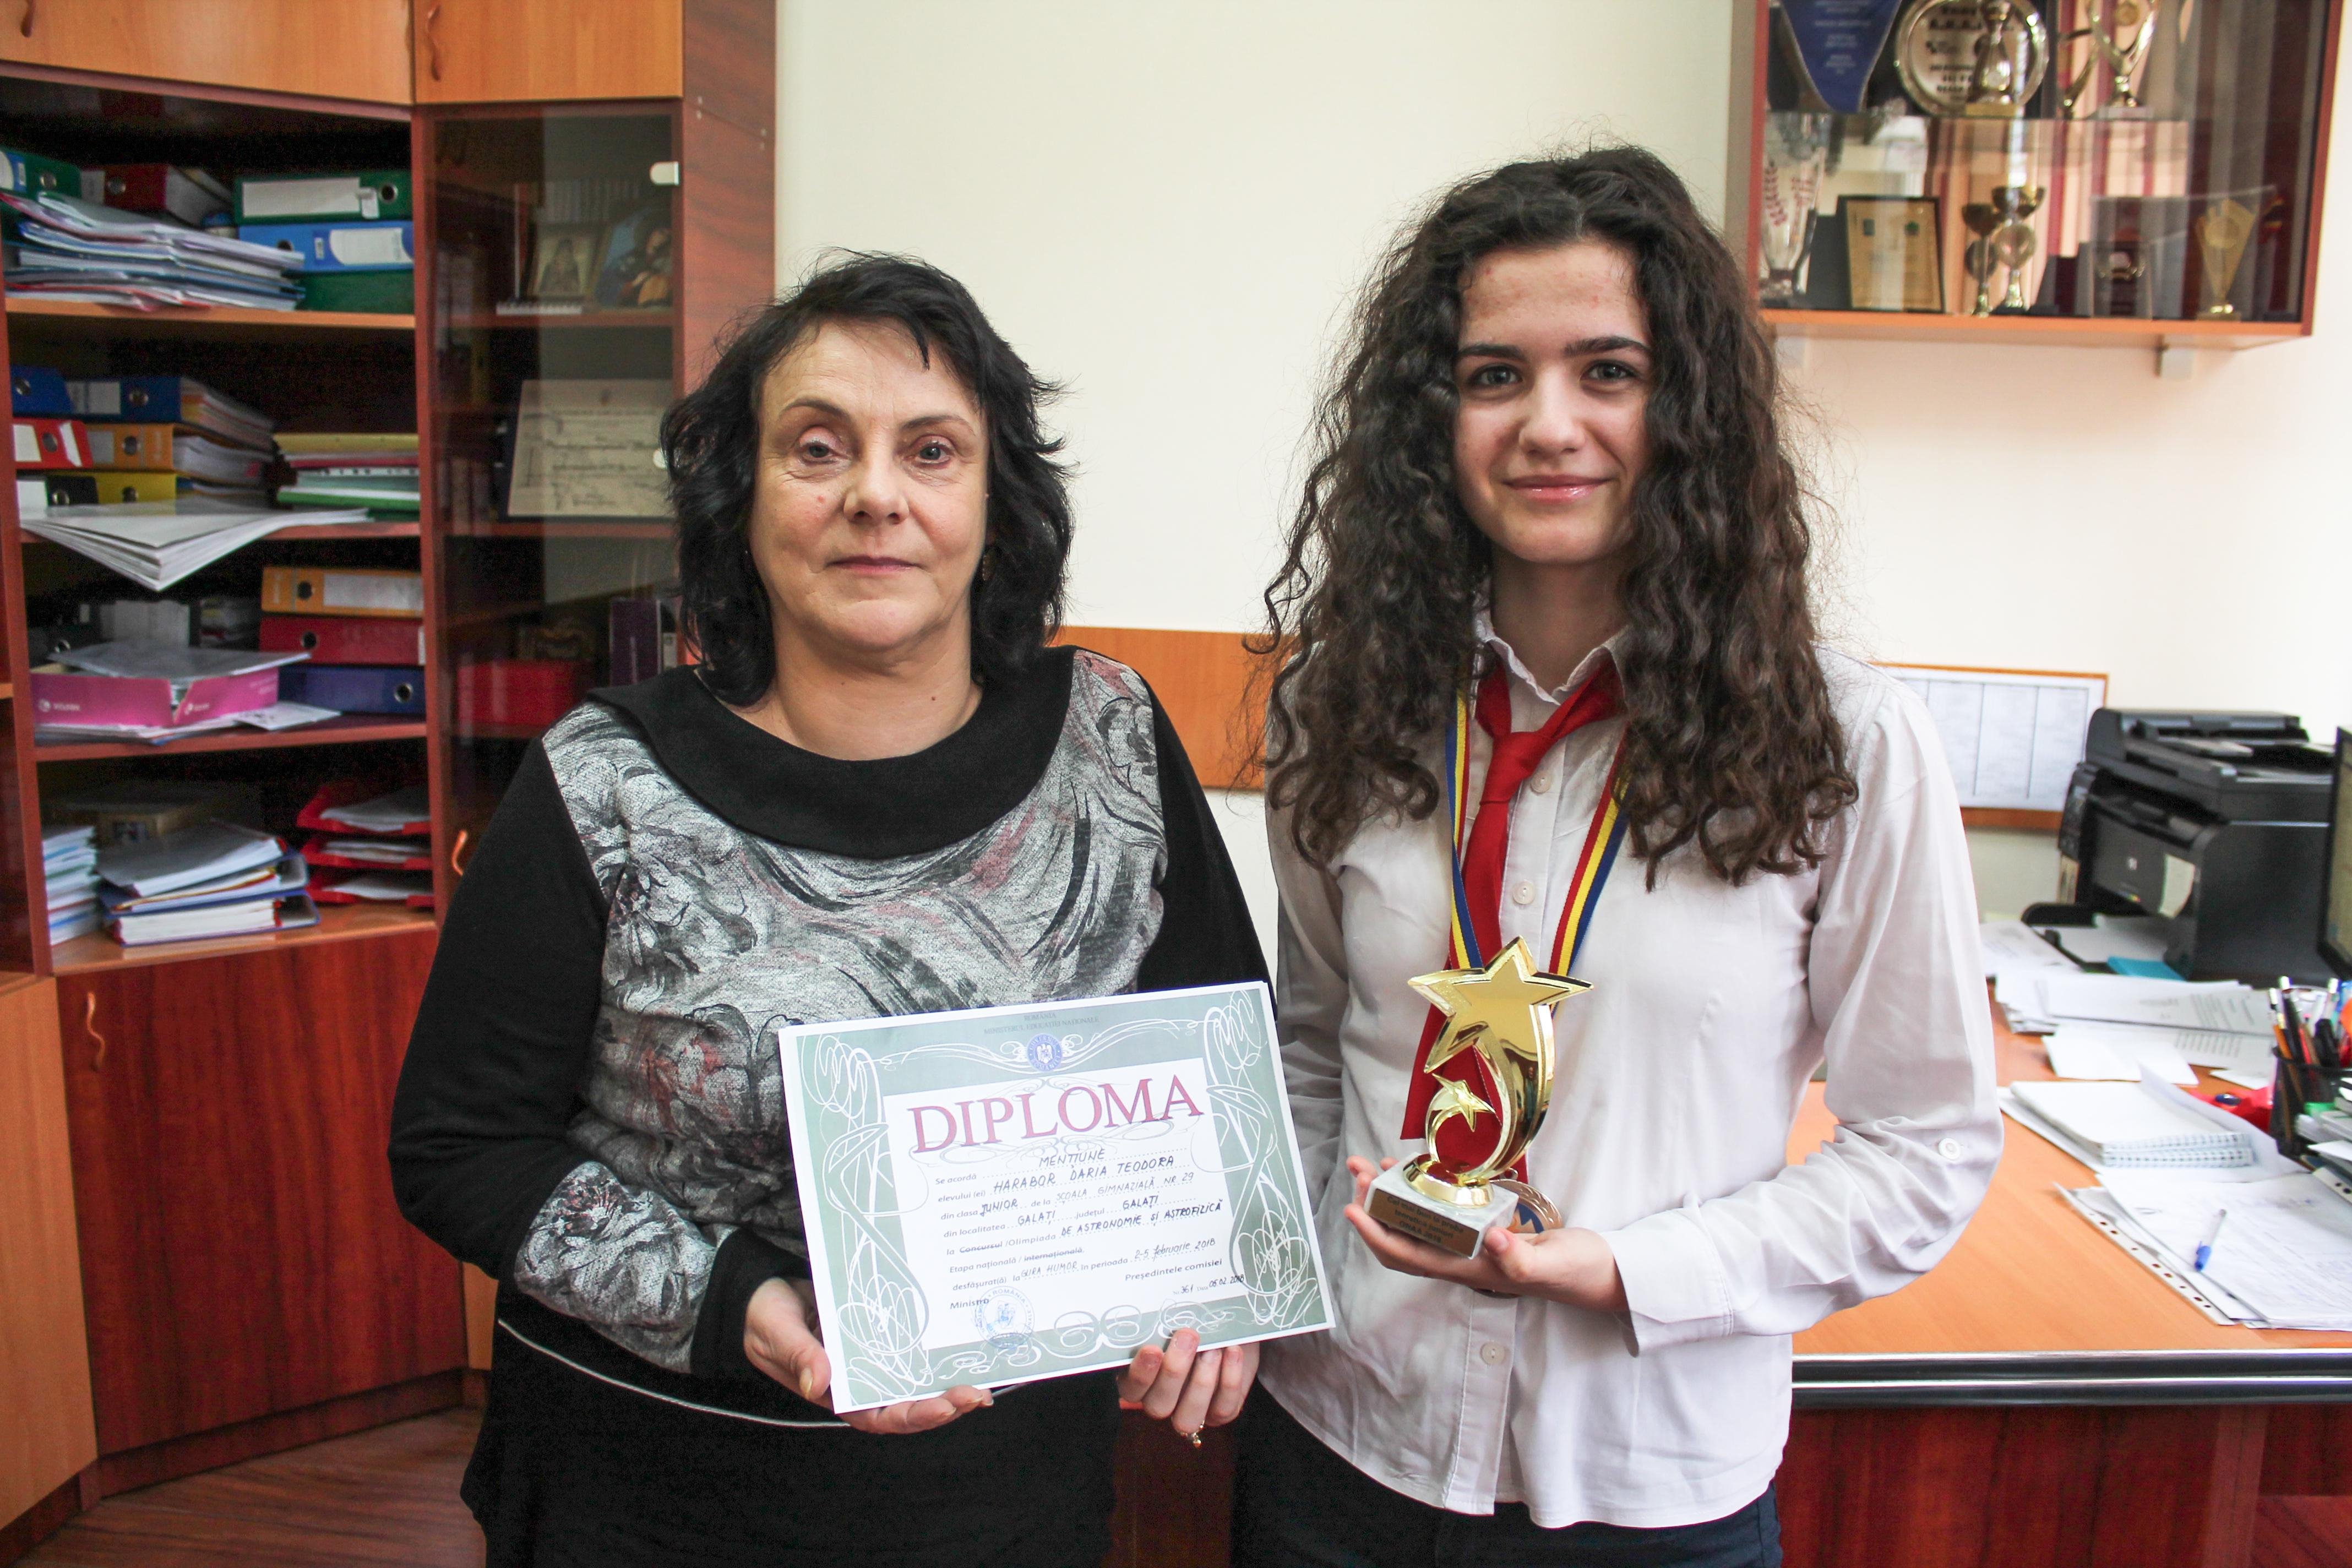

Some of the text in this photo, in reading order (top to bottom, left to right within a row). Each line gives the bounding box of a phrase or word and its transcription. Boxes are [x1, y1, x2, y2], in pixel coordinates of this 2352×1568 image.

[907, 1074, 1205, 1153] DIPLOMA
[948, 1174, 977, 1183] acordă
[993, 1156, 1174, 1193] HARABOR DARIA TEODORA
[1164, 1175, 1176, 1184] NR
[1182, 1172, 1194, 1181] 29
[938, 1190, 986, 1202] elevului (ei)
[956, 1209, 978, 1218] clasa
[979, 1199, 1018, 1217] JUNIOR
[960, 1223, 1006, 1235] localitatea
[1061, 1226, 1073, 1237] DE
[1195, 1238, 1216, 1250] 2018
[949, 1264, 974, 1273] Etapa
[1021, 1260, 1078, 1277] GURA HUMOR
[1091, 1257, 1128, 1270] perioada
[1184, 1258, 1223, 1272] comisiei
